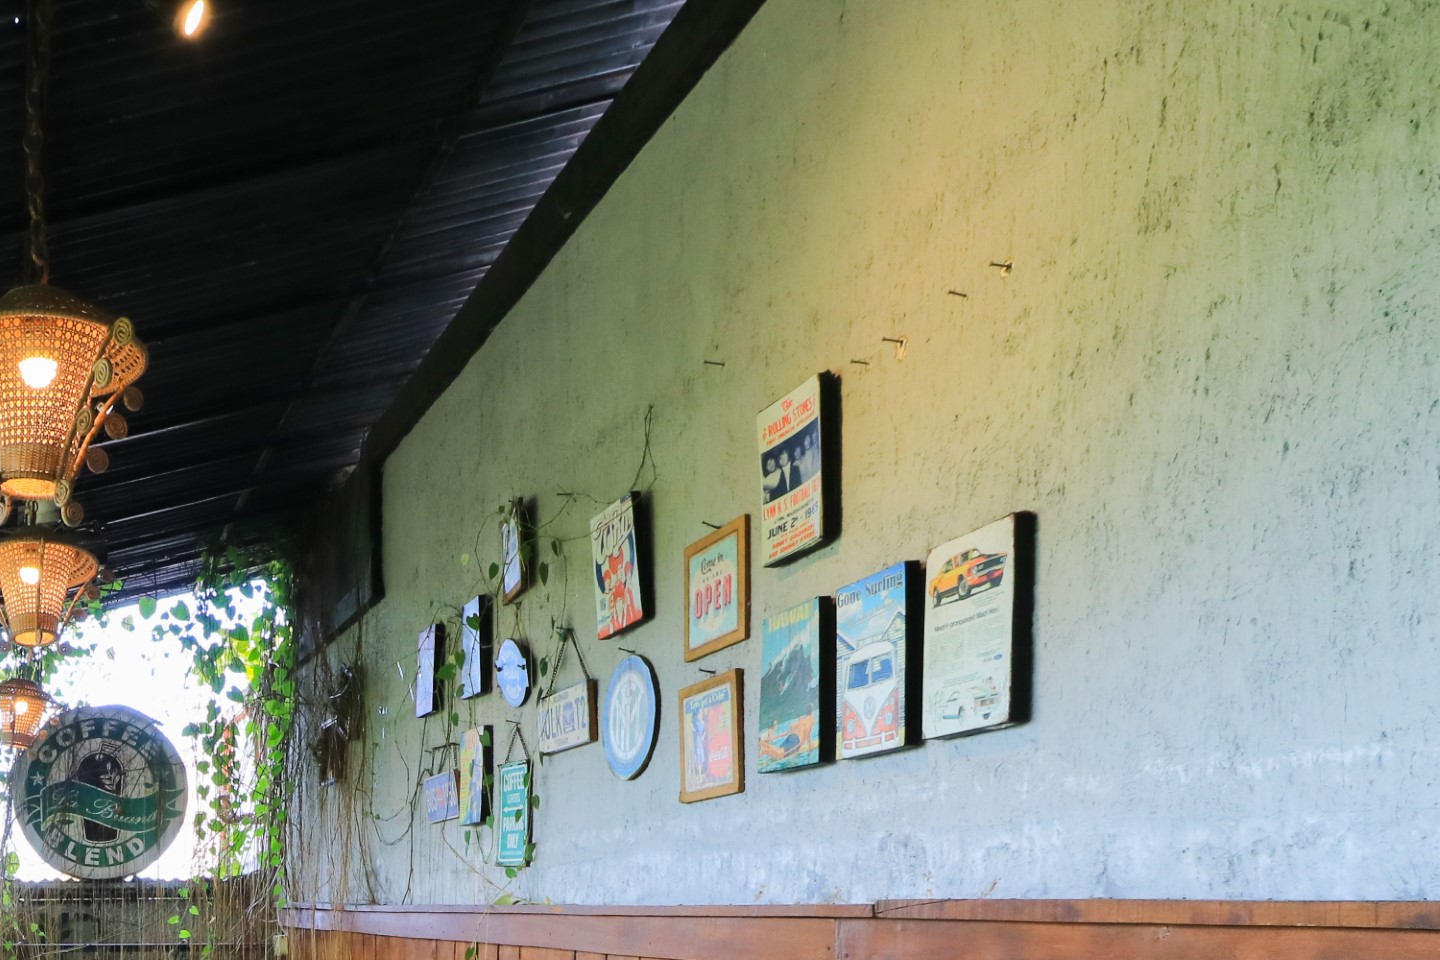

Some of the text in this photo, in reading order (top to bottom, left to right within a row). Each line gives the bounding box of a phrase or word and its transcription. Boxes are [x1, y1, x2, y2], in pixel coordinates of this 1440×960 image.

[767, 521, 788, 540] JUNE
[701, 558, 716, 574] Come
[694, 574, 732, 619] OPEN
[837, 570, 903, 608] Gone Surfing
[574, 696, 587, 730] T2
[503, 771, 524, 792] COFFEE
